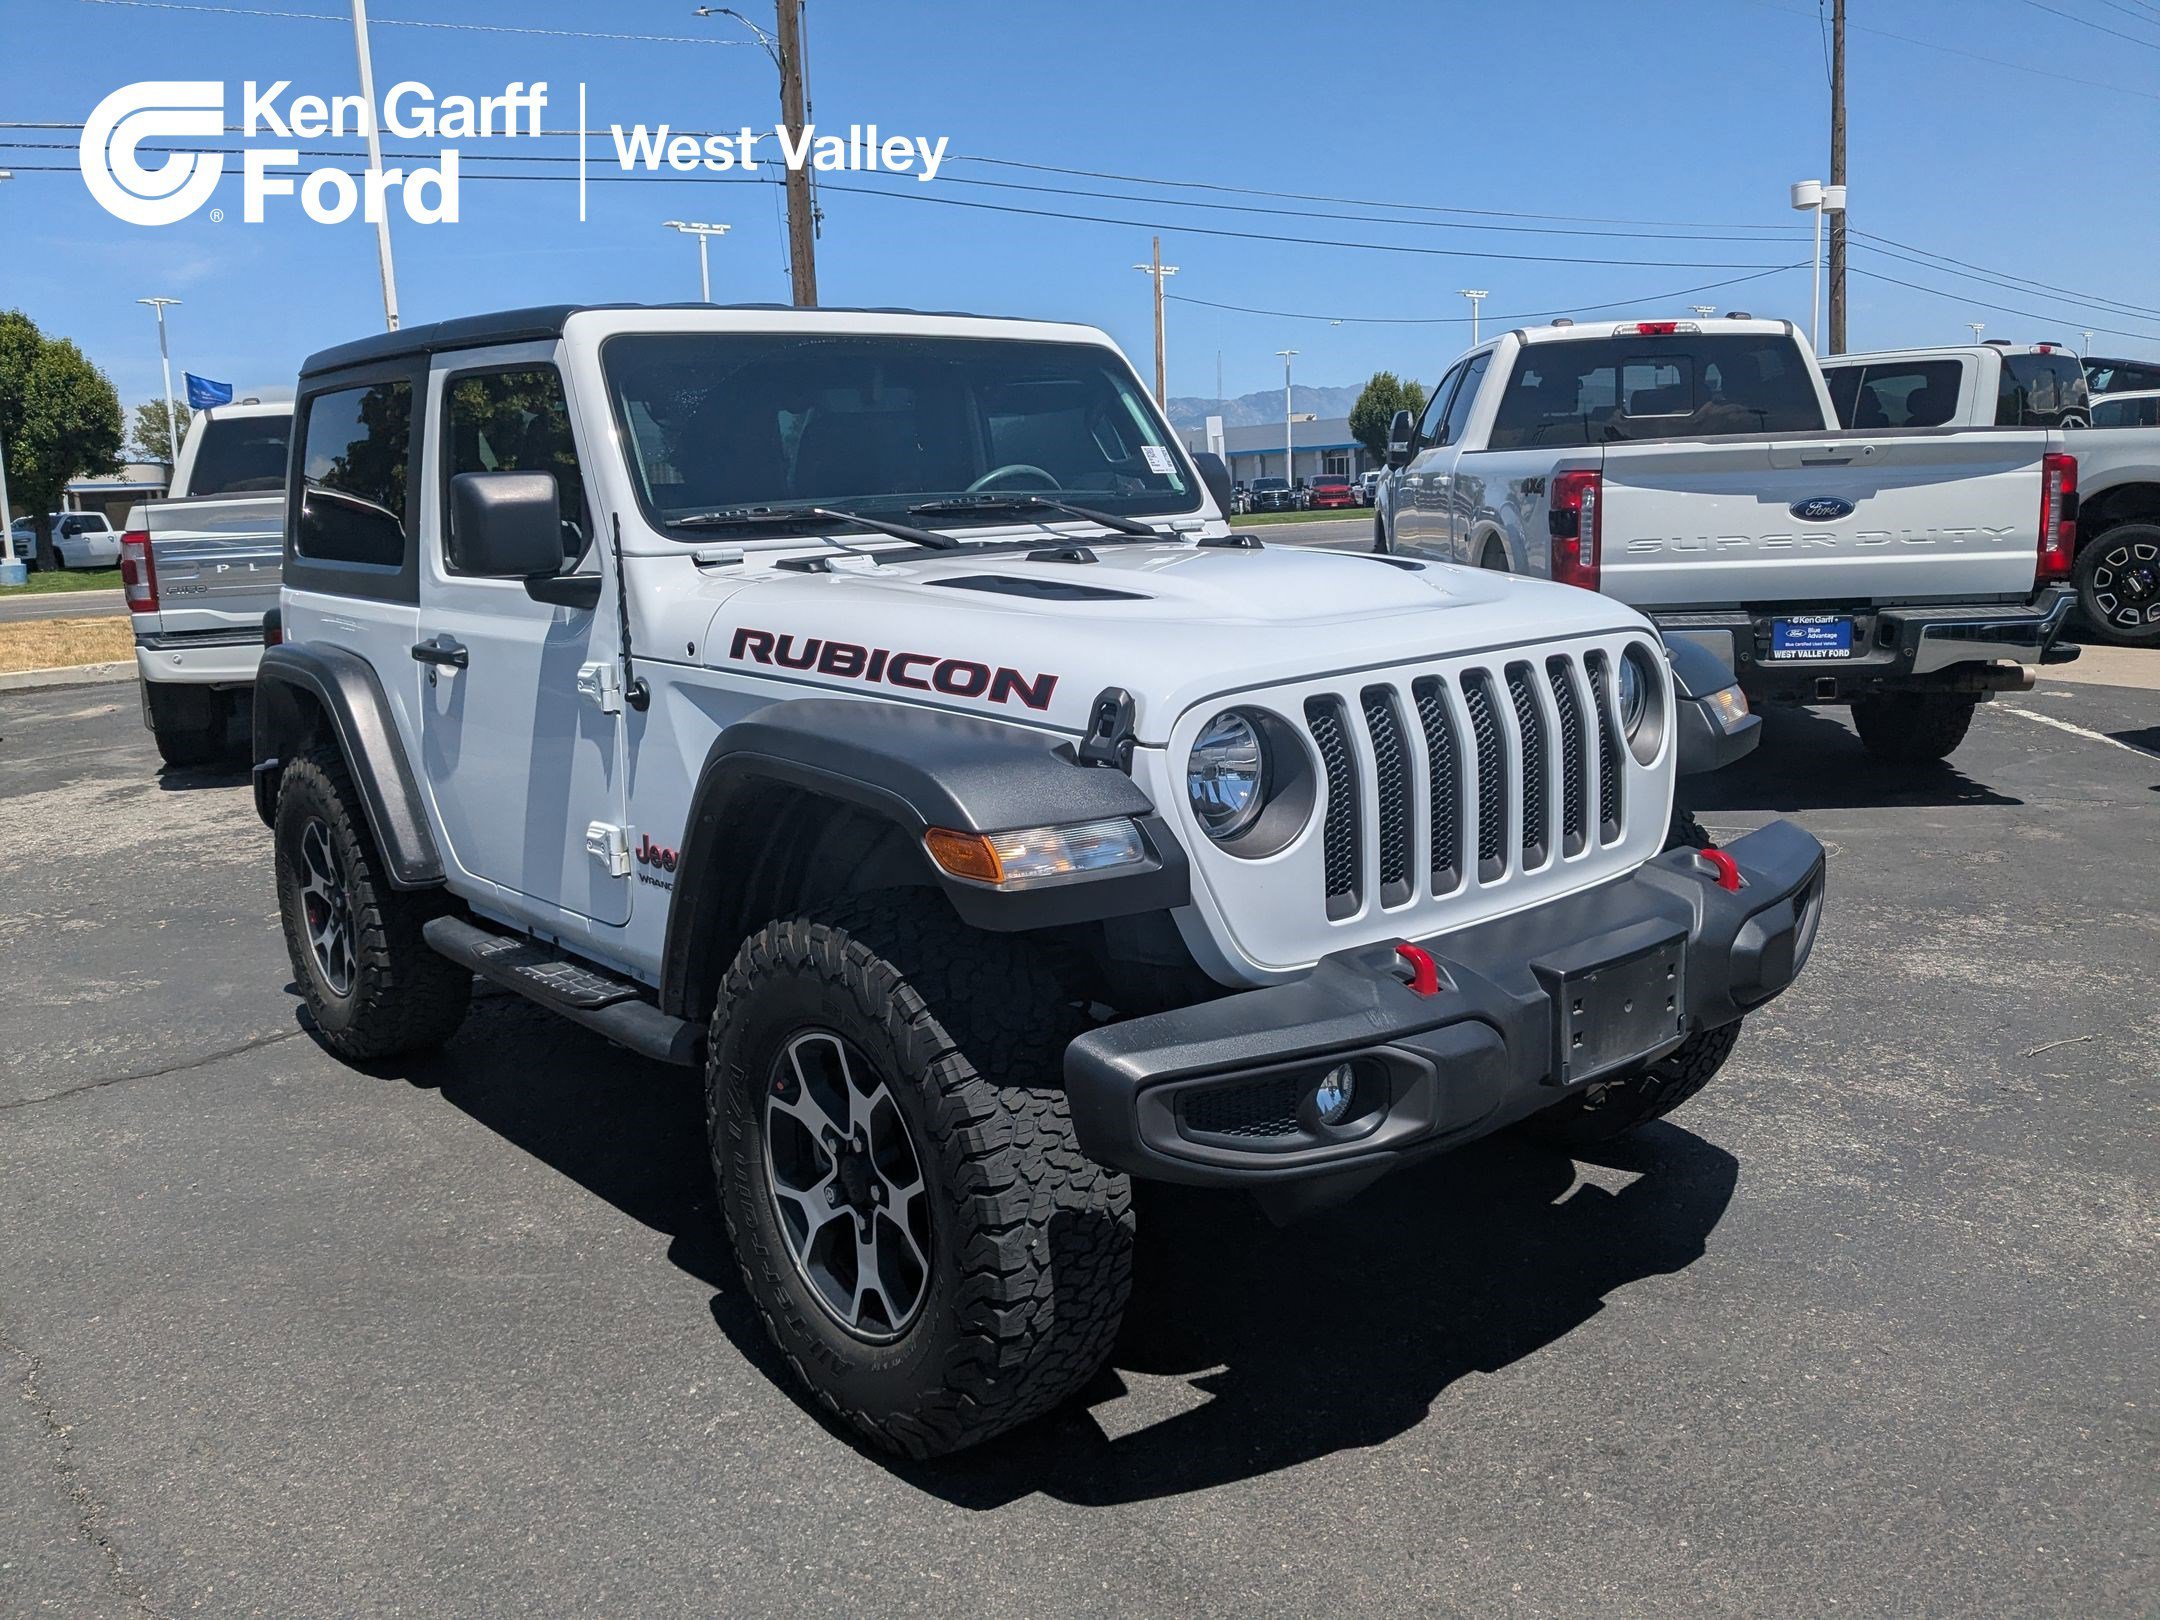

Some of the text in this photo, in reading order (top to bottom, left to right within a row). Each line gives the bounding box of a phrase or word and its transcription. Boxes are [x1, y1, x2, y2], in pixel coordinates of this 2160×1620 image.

[1805, 501, 1841, 516] Ford
[1626, 526, 2015, 554] SUPER DUTY
[1800, 616, 1834, 624] Ken Garff
[1774, 649, 1850, 658] WEST VALLEY FORD
[729, 627, 1059, 711] RUBICON
[635, 833, 680, 873] Jee
